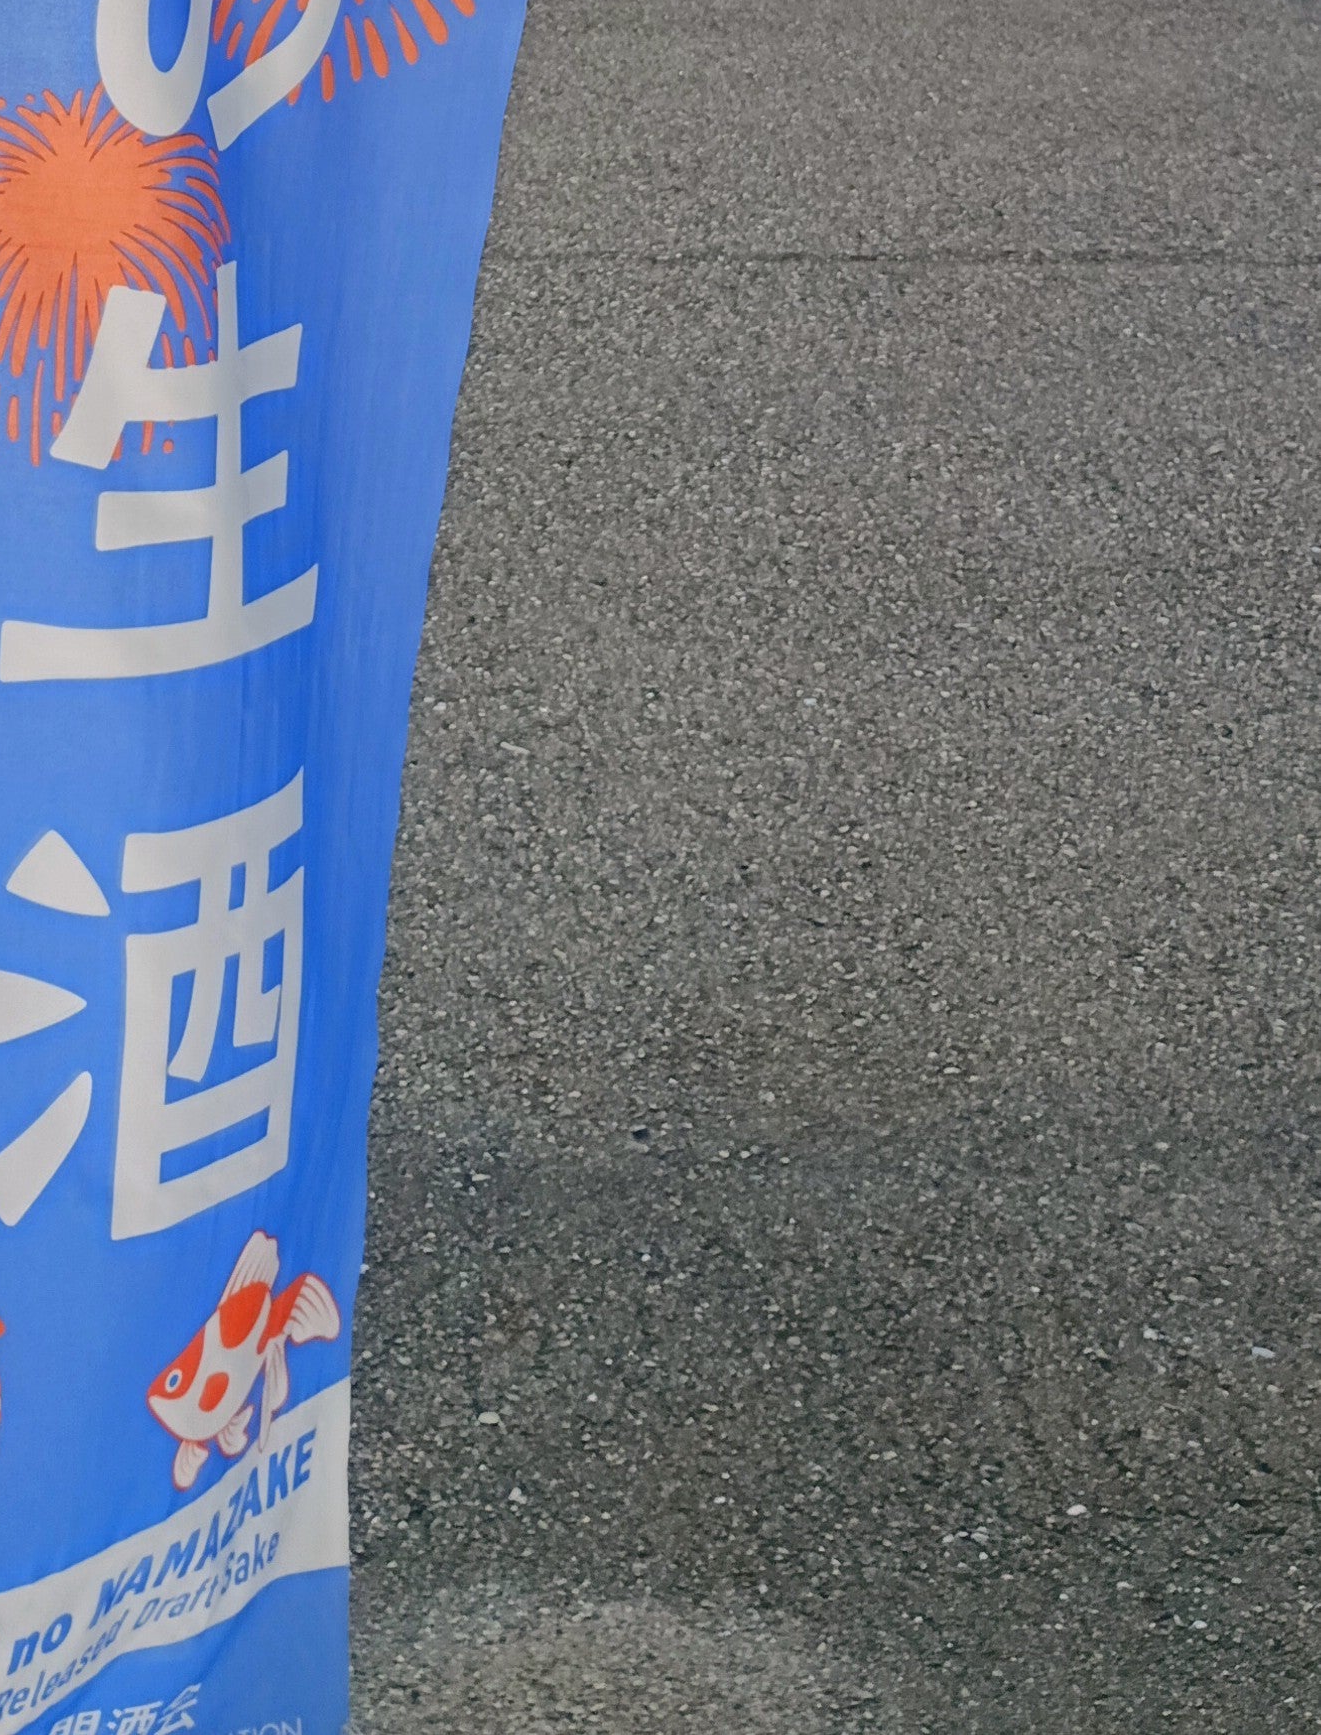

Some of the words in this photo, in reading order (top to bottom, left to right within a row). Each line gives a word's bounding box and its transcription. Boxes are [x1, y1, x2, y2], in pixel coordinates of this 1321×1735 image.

[7, 1613, 73, 1676] no
[89, 1428, 317, 1630] NAMAZAKE
[132, 1576, 220, 1632] Draft
